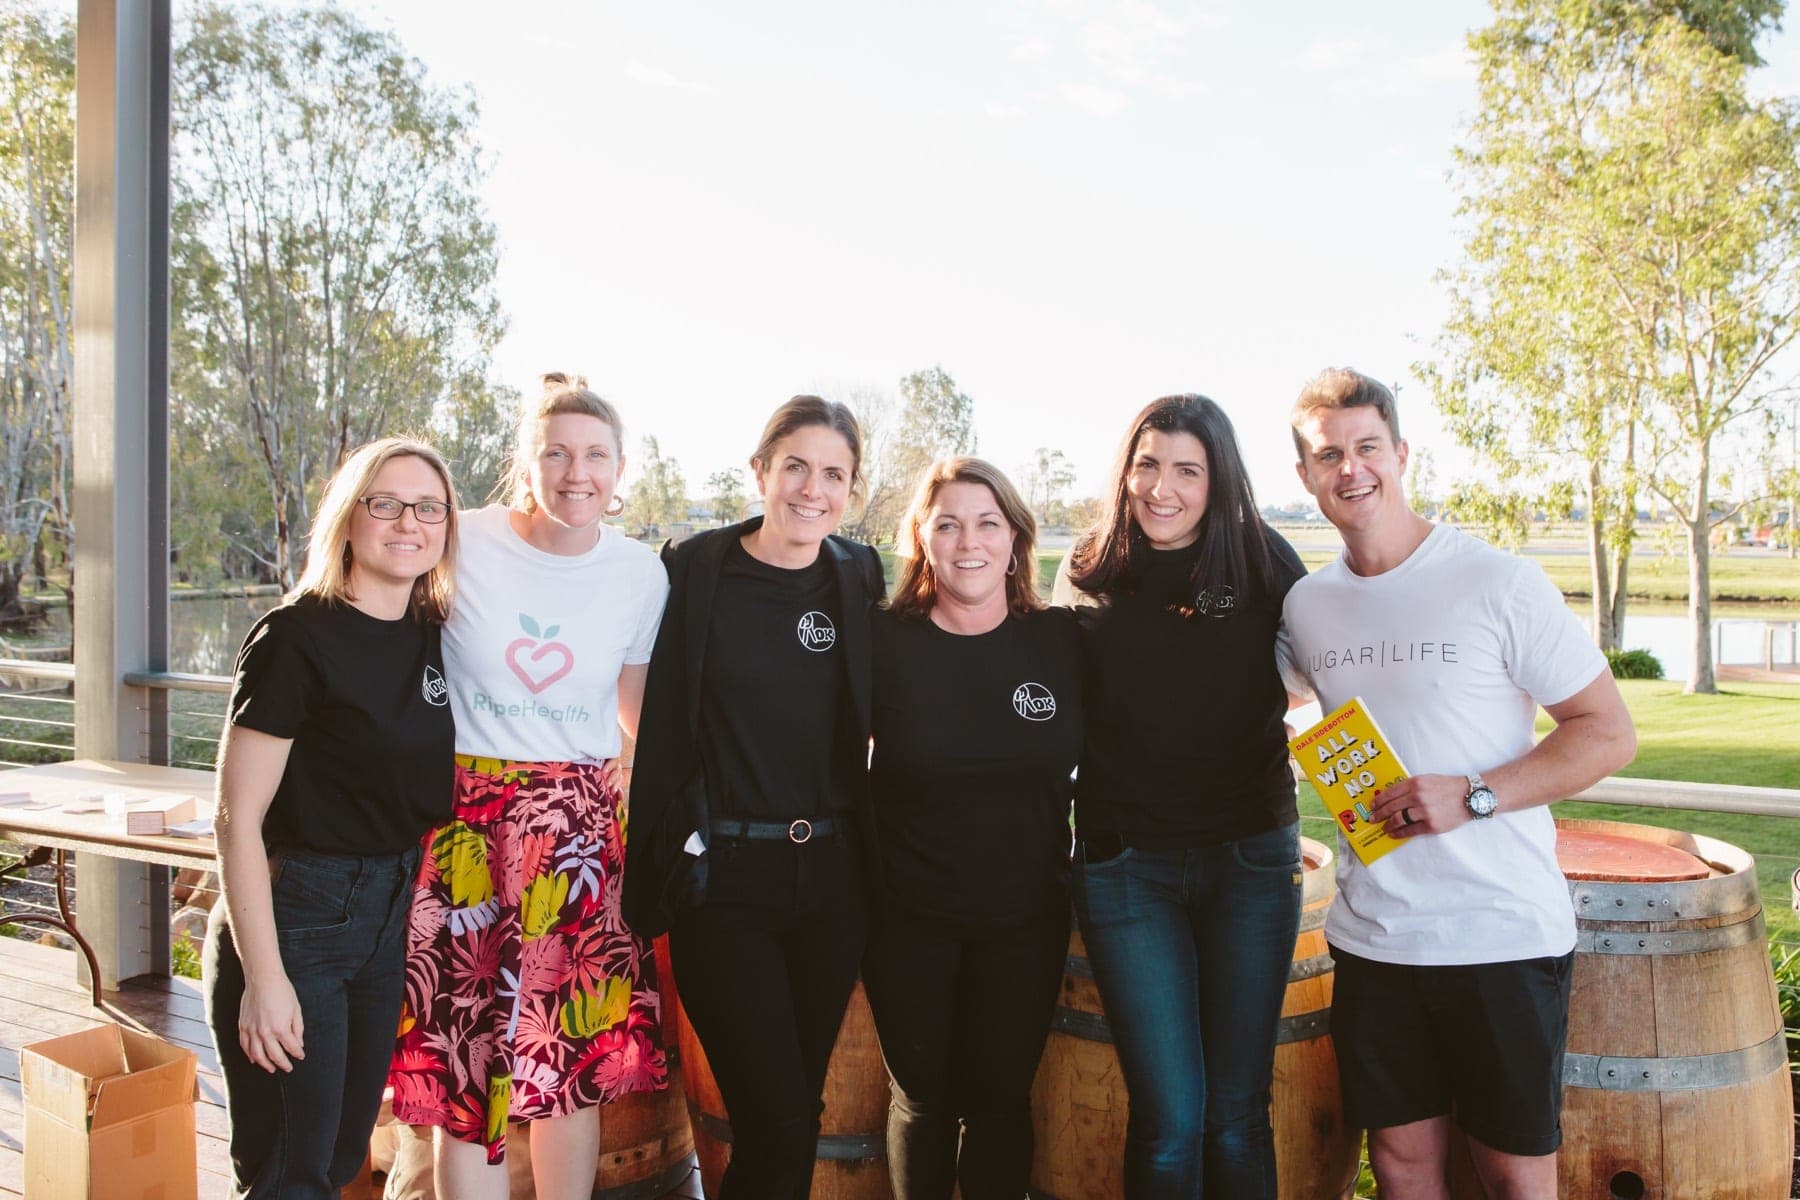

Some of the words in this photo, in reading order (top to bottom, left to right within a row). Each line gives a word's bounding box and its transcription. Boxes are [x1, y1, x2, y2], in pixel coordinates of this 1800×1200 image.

[473, 692, 589, 722] RipeHealth
[1296, 732, 1314, 751] DALE
[1313, 708, 1356, 737] SIDEBOTTOM
[1317, 730, 1358, 763] ALL
[1316, 740, 1381, 787] WORK
[1344, 771, 1376, 798] NO
